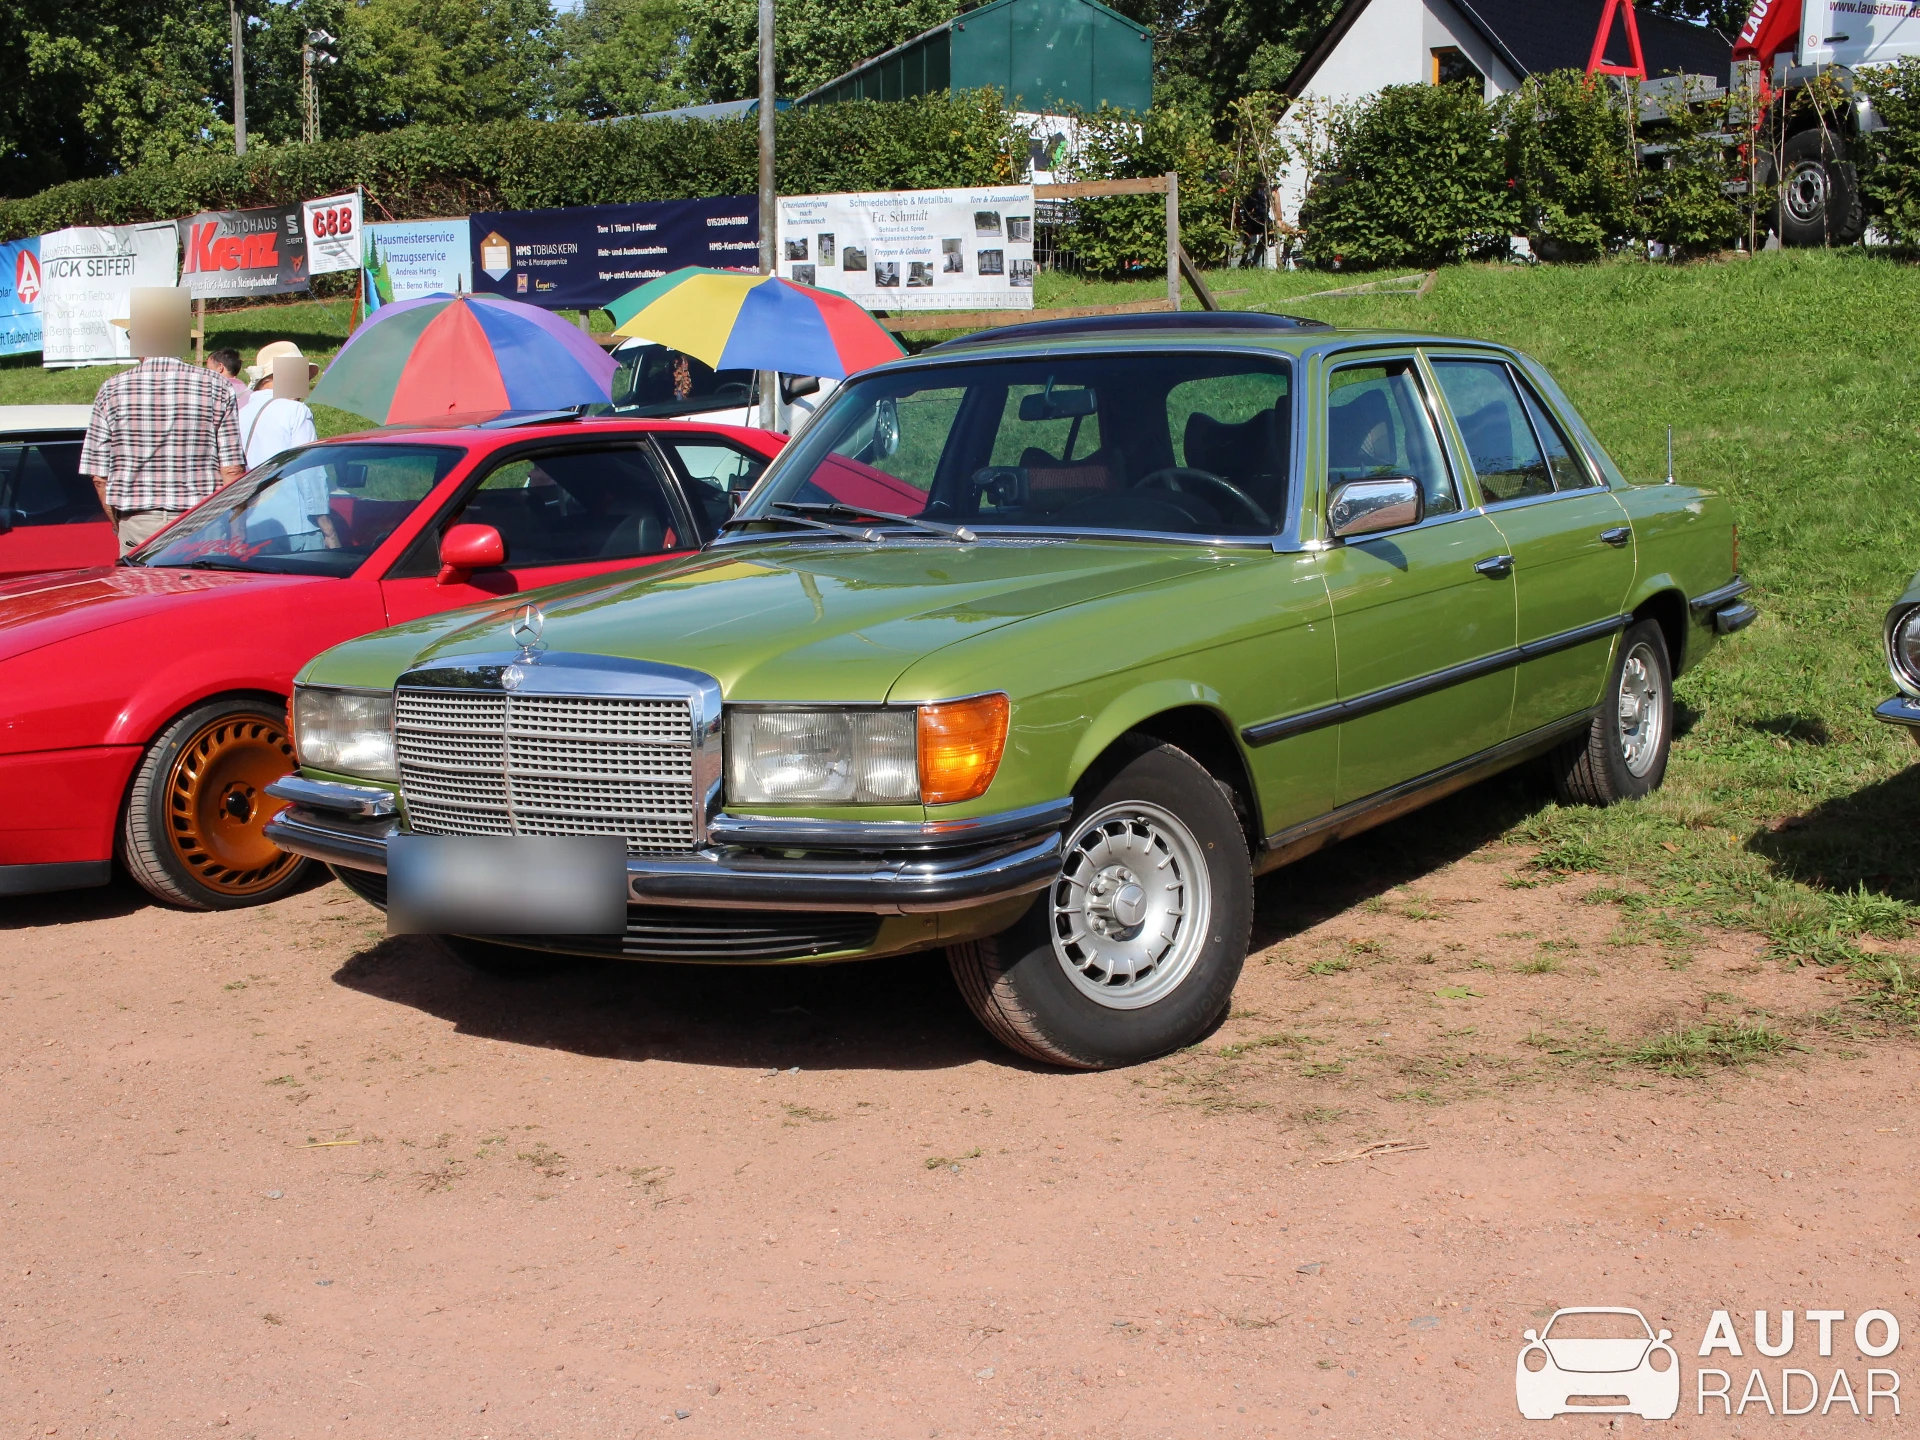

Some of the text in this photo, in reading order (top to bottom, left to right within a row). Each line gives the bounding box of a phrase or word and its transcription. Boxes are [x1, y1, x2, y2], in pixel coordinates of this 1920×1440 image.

[1829, 1, 1920, 18] www.lausitzlift.de
[1741, 0, 1773, 44] LAU
[849, 195, 953, 208] Schmiedebetrieb & Metallbau
[970, 196, 981, 204] Tore
[990, 194, 1029, 203] Zaunanlagen
[799, 209, 813, 217] nach
[872, 209, 929, 223] Fa. Schmidt
[221, 217, 278, 235] AUTOHAUS
[313, 207, 352, 237] GBB
[597, 222, 657, 234] Tore Türen Fenster
[376, 231, 455, 246] Hausmeisterservice
[184, 221, 279, 274] Krenz
[515, 243, 578, 256] HMS TOBIAS KERN
[611, 248, 622, 257] und
[622, 246, 668, 257] Ausbauarbeiten
[709, 240, 760, 251] HMS-Kern@web.d
[386, 250, 446, 266] Umzugsservice
[874, 248, 898, 257] Treppen
[86, 256, 135, 277] SEIFERT
[516, 257, 568, 267] Holz- & Montageservice
[395, 266, 437, 277] Andreas Hartig
[598, 271, 613, 281] Vinyl-
[613, 270, 625, 279] und
[423, 281, 444, 290] Richter
[65, 291, 87, 302] und
[87, 289, 116, 302] Tiefbau
[57, 308, 75, 319] und
[79, 308, 105, 319] Ausbau
[43, 325, 107, 338] ußengestaltung
[44, 343, 99, 355] atursteinbau
